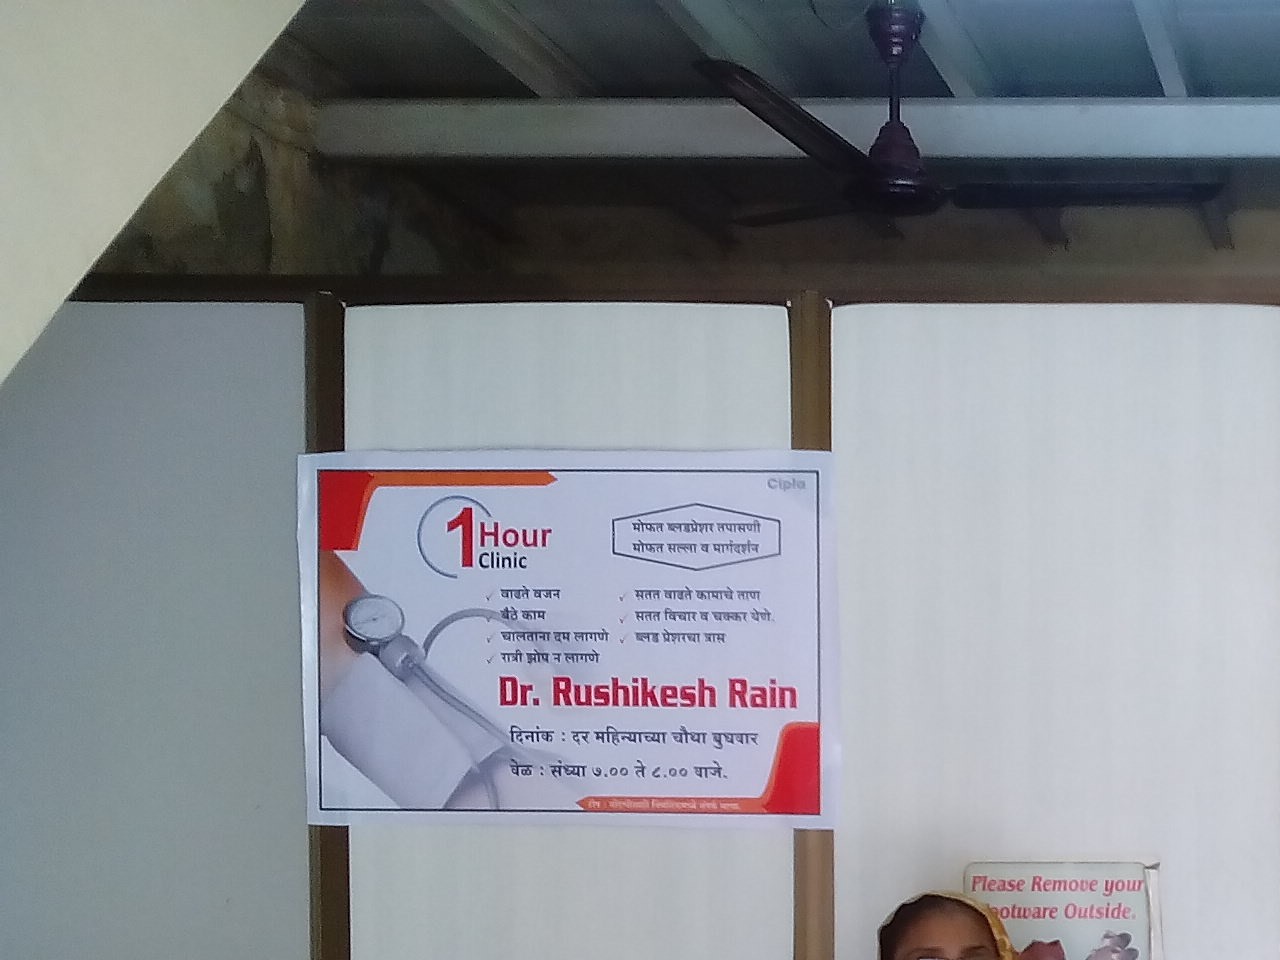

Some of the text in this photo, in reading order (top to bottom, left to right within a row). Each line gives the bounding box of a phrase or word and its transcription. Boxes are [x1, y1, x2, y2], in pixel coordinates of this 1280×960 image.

[767, 478, 806, 491] Cipla
[632, 519, 664, 533] मोफत
[717, 519, 760, 534] तपासणी
[446, 507, 552, 567] 1 Hour
[632, 539, 664, 554] मोफत
[667, 542, 697, 554] सल्ला
[700, 542, 710, 554] व
[479, 551, 527, 569] Clinic
[500, 585, 560, 600] वाढते वजन
[635, 585, 760, 601] सतत वाढते कामाचे ताण
[500, 606, 546, 620] बैठे काम
[635, 610, 660, 622] सतत
[664, 608, 697, 622] विचार
[700, 610, 709, 622] व
[711, 611, 748, 622] चक्कर
[500, 627, 609, 643] चालताना दम लागणे
[634, 631, 660, 643] ब्लड
[500, 648, 600, 664] रात्री झोप न लागणे
[499, 676, 798, 709] Dr. Rushikesh Rain
[509, 725, 555, 744] दिनांक
[571, 731, 590, 745] दर
[593, 725, 667, 746] महिन्याच्या
[671, 725, 707, 744] चौथा
[509, 758, 533, 777] वेळ
[549, 759, 587, 778] संध्या
[634, 759, 646, 778] ते
[971, 875, 1145, 896] Please Remove your
[986, 902, 1137, 920] otware Outside.
